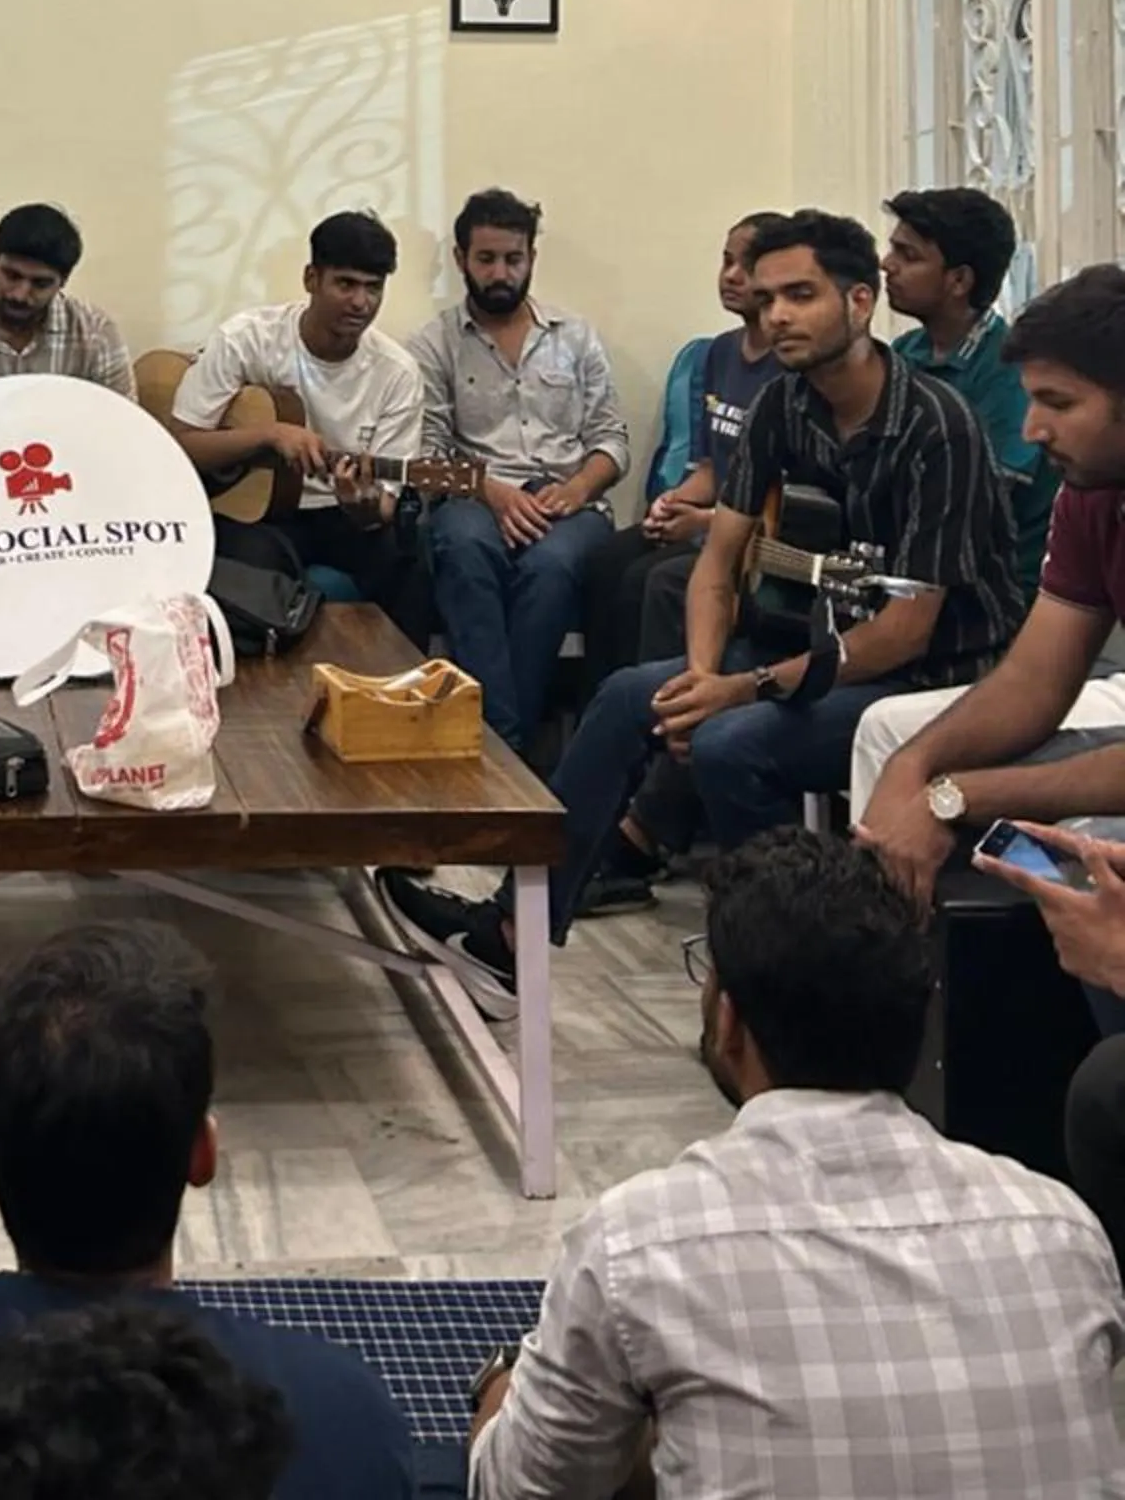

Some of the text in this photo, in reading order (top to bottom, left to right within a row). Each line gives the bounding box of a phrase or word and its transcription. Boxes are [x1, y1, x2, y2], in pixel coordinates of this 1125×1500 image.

[104, 519, 188, 545] SPOT
[16, 549, 67, 564] CREATE
[76, 545, 135, 559] CONNECT
